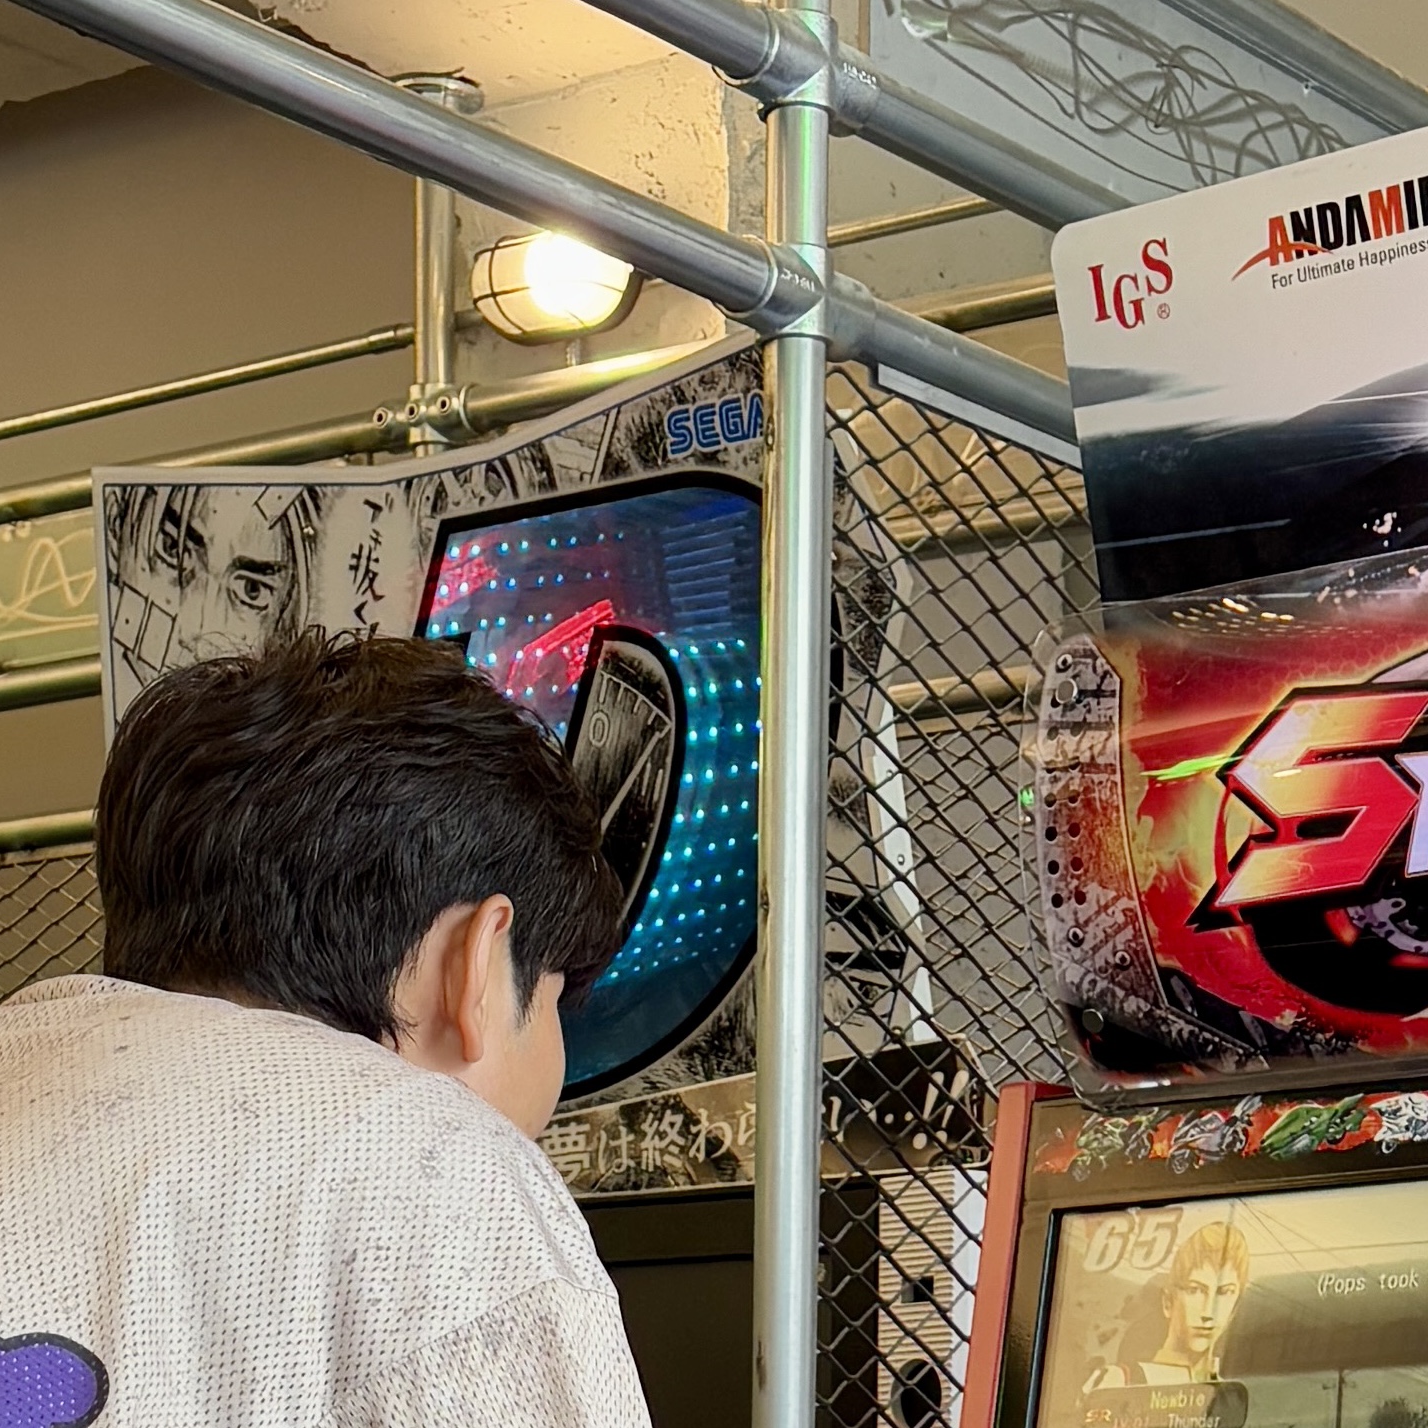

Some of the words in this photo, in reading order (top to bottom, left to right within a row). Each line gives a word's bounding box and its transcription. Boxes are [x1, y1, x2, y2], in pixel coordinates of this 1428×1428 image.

[1087, 237, 1172, 329] IGS
[1272, 273, 1293, 290] For
[1297, 257, 1355, 284] Ultimate
[667, 392, 764, 455] SEGA
[1379, 1271, 1419, 1289] took
